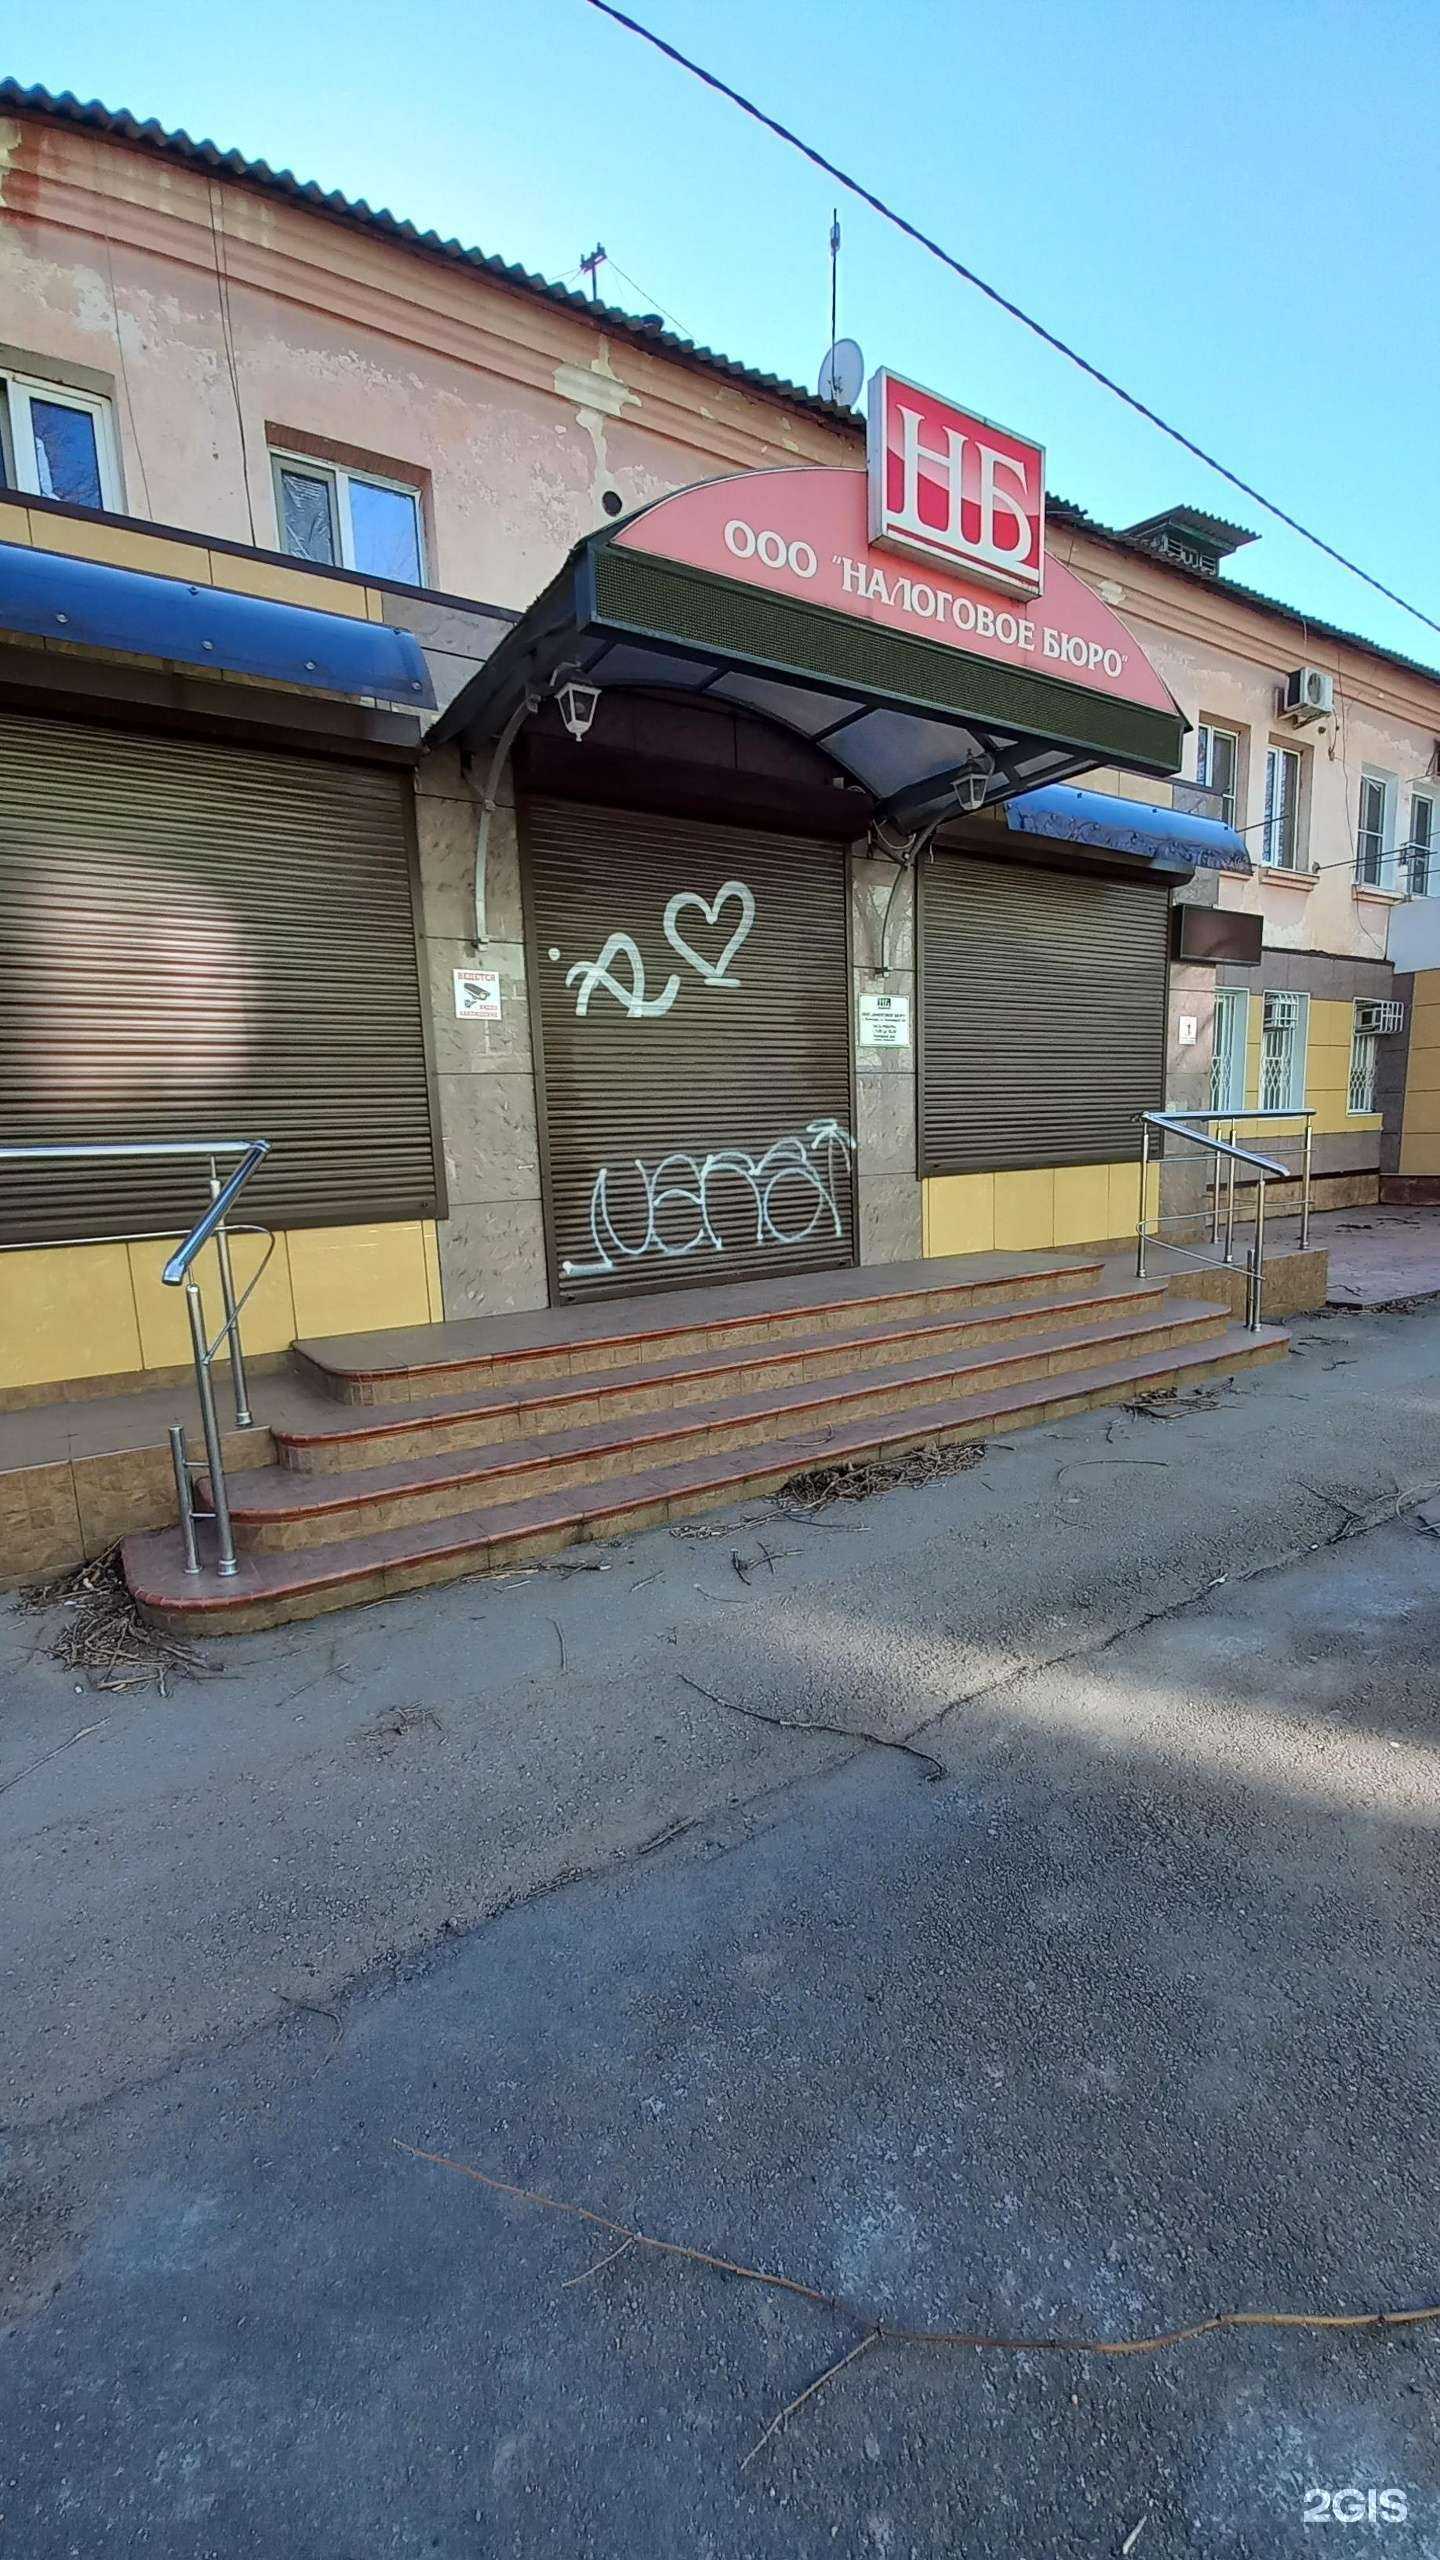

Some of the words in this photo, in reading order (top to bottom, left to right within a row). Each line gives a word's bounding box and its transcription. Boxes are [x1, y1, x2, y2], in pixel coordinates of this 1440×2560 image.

[895, 403, 1033, 567] НБ
[724, 519, 818, 579] ООО
[832, 554, 1035, 652] "НАЛОГОВОЕ
[1042, 626, 1128, 678] БЮРО"
